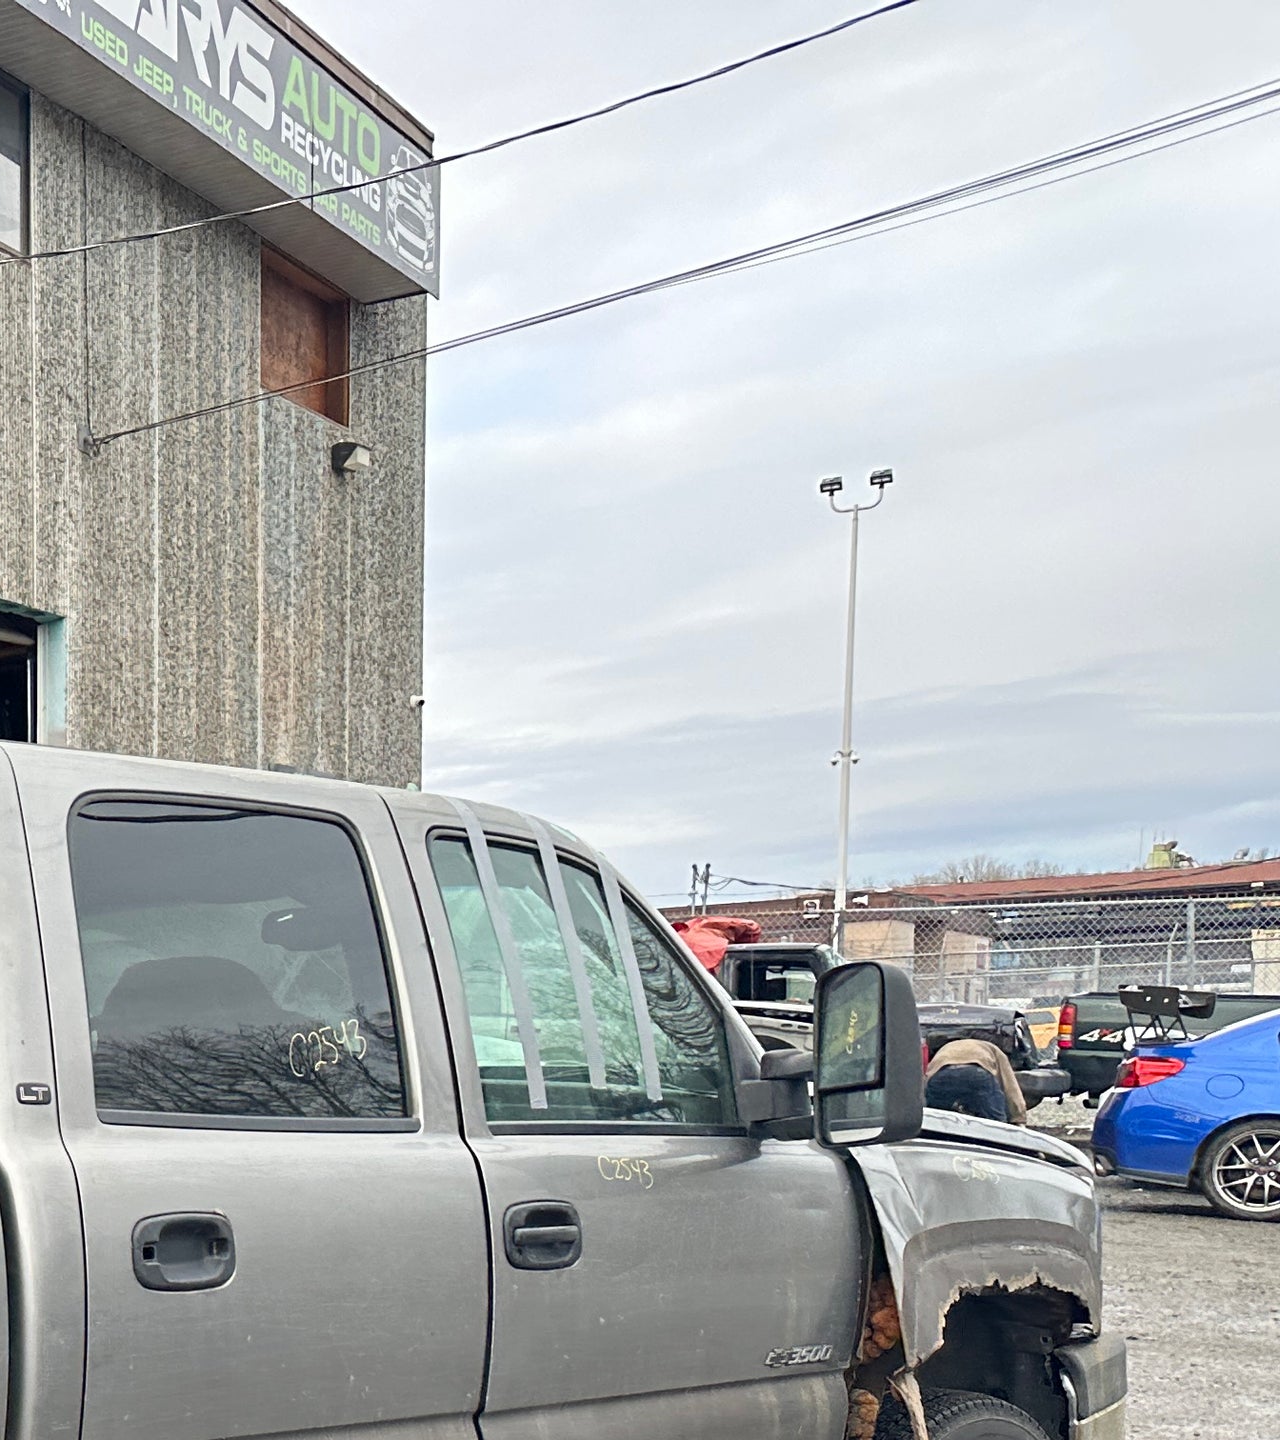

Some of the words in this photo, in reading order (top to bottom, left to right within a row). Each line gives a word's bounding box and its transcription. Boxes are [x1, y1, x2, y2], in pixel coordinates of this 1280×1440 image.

[81, 12, 129, 67] USED
[133, 54, 178, 109] JEEP,
[183, 85, 233, 141] TRUCK
[237, 126, 249, 152] &
[253, 138, 307, 195] SPORTS
[342, 202, 381, 246] PARTS
[282, 55, 381, 177] AUTO
[281, 111, 381, 213] RECYCLING
[289, 1018, 367, 1077] C2543
[19, 1086, 49, 1101] LT
[597, 1155, 654, 1190] C2543
